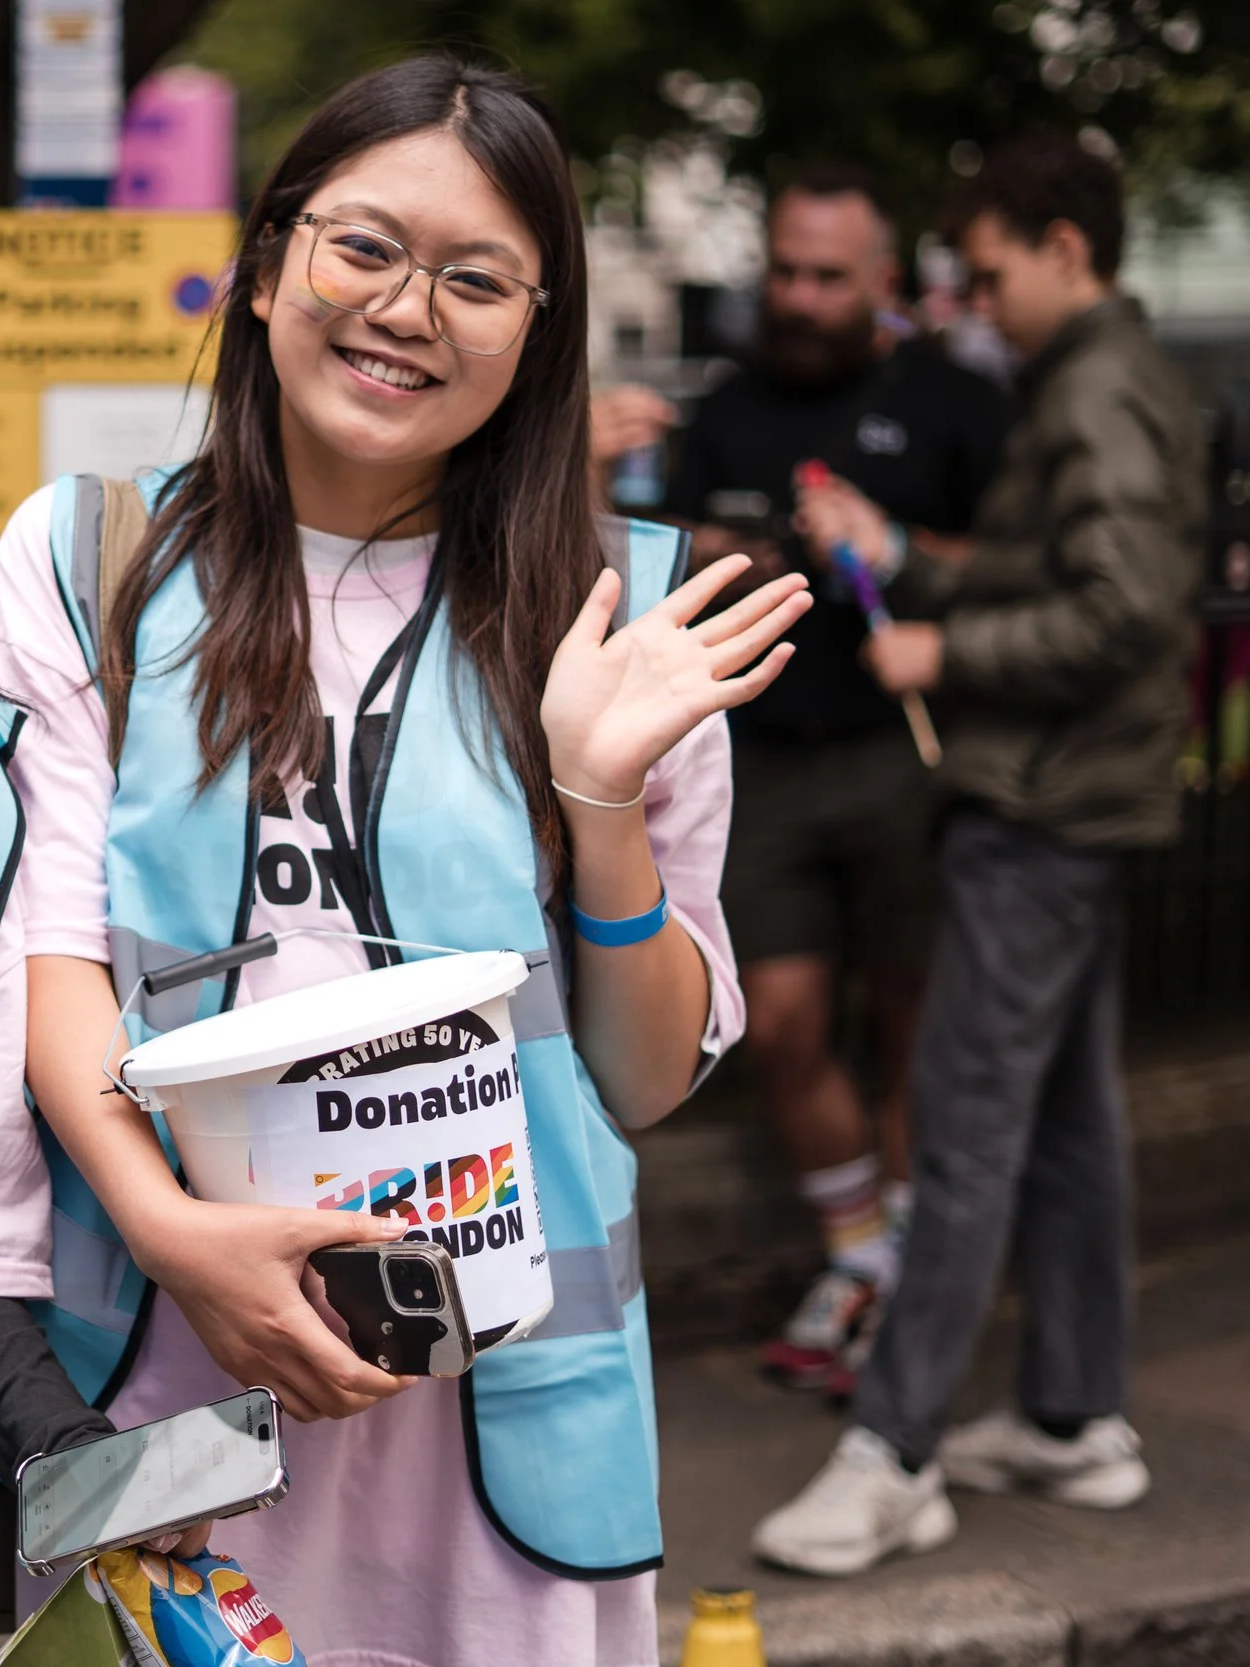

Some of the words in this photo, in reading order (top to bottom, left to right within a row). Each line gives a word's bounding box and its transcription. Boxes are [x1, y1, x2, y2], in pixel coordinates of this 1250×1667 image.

[423, 1025, 452, 1046] 50
[459, 1027, 488, 1054] YE
[316, 1064, 512, 1132] Donation
[245, 1405, 253, 1436] DONATION
[225, 1594, 273, 1636] WALKE
